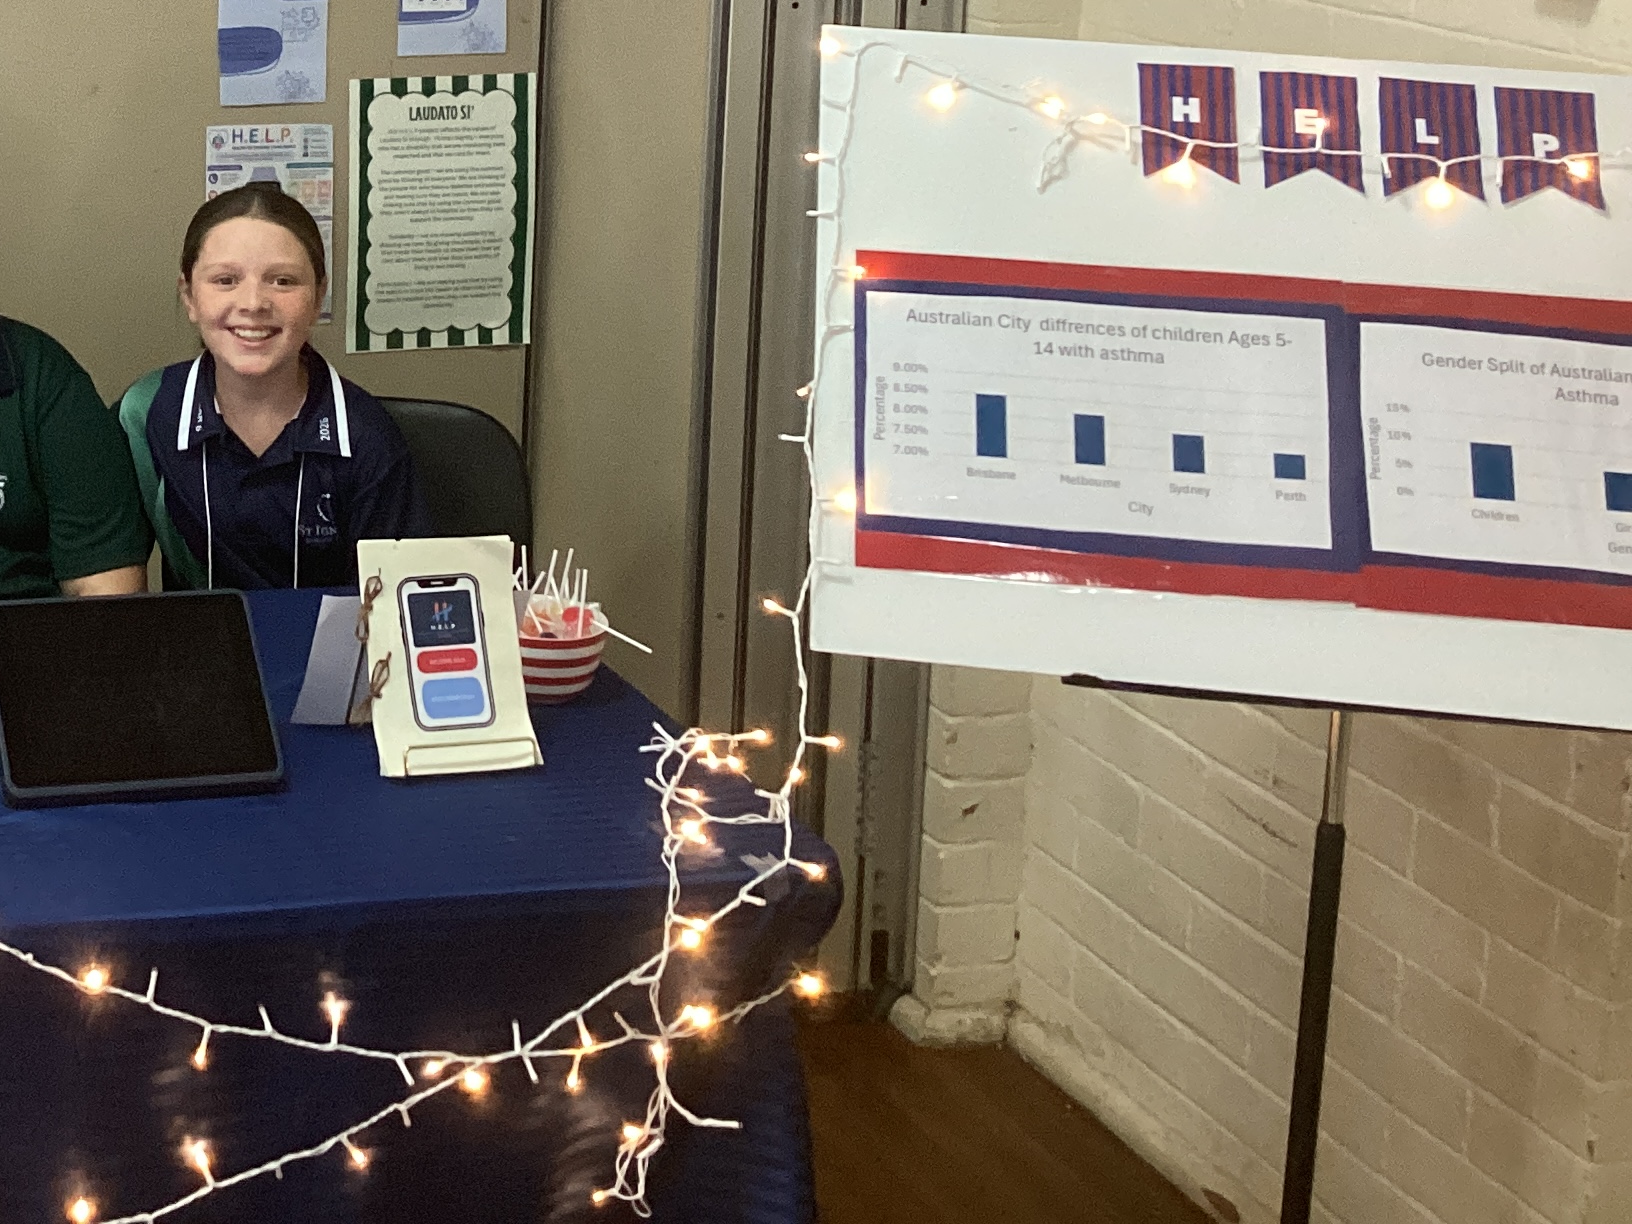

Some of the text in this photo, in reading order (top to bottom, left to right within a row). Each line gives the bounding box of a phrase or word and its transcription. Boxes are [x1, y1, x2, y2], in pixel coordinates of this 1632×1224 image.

[409, 105, 458, 121] LAUDATO
[1171, 95, 1560, 158] HELP
[906, 308, 1294, 349] Australian City diffrences of children Ages 5-
[1033, 341, 1165, 365] 14 with asthma
[1422, 352, 1632, 384] Gender Split of Australian
[1555, 387, 1620, 406] Asthma
[873, 375, 886, 441] Percentage
[893, 403, 929, 415] 8.00%
[1386, 403, 1410, 413] 15%
[319, 417, 331, 441] 2026
[893, 424, 929, 436] 7.50%
[1387, 431, 1411, 441] 10%
[893, 444, 929, 457] 7.00%
[1369, 417, 1381, 480] Percentage
[1169, 482, 1211, 499] Sydney
[1275, 489, 1307, 502] Perth
[1128, 501, 1154, 516] City
[1471, 508, 1520, 523] Children
